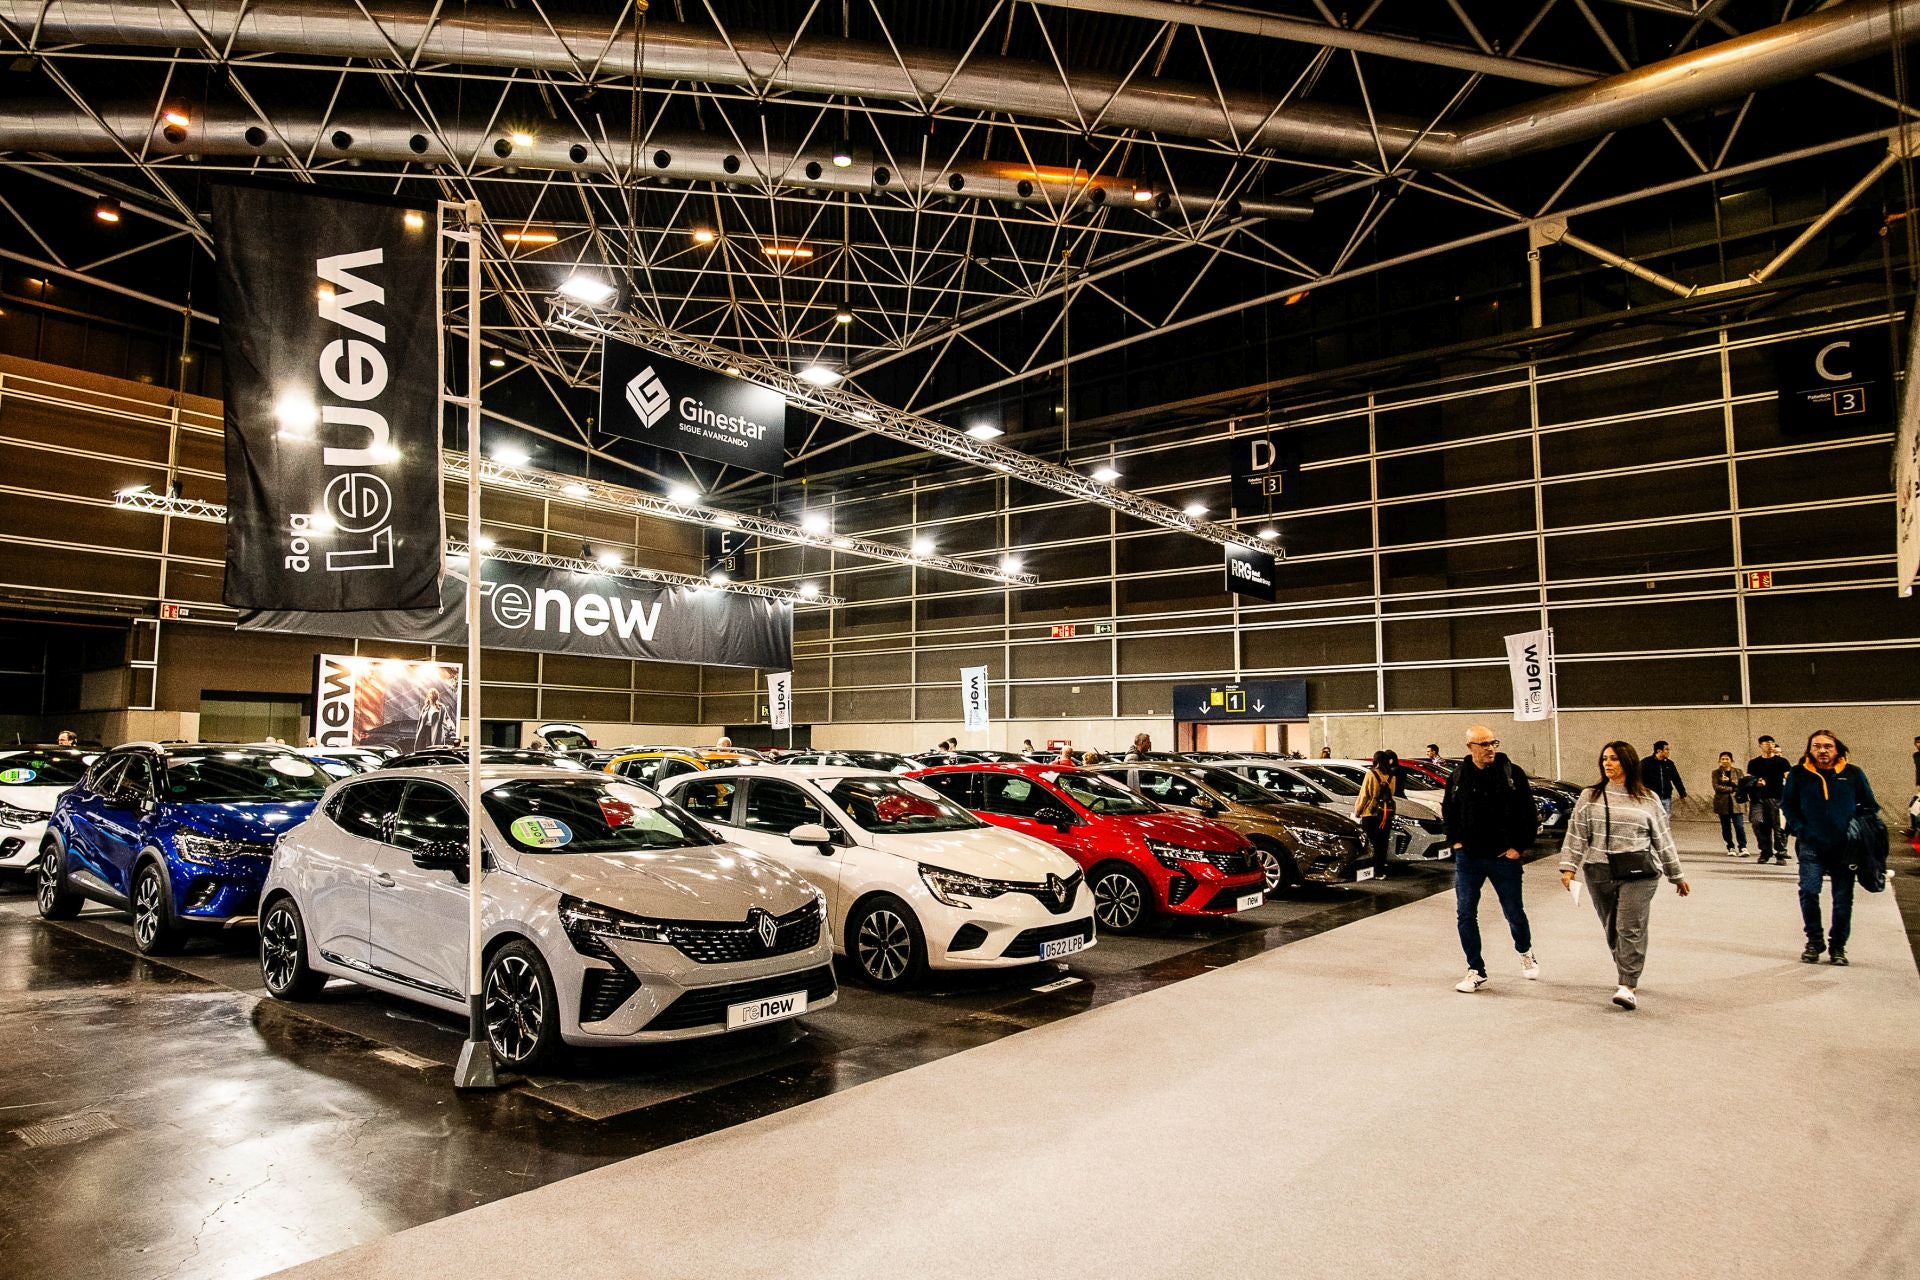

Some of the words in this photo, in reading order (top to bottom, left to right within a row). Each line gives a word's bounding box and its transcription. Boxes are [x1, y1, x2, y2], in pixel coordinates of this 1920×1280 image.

[1815, 341, 1853, 381] C
[1842, 393, 1856, 410] 3
[679, 396, 767, 441] Ginestar
[679, 422, 702, 436] SIGUE
[702, 429, 749, 448] AVANZANDO
[1251, 439, 1276, 471] D
[1268, 478, 1277, 492] 3
[721, 531, 731, 554] E
[727, 559, 733, 569] 3
[1231, 558, 1252, 580] RRG
[465, 580, 663, 642] renew
[1230, 694, 1238, 709] 1
[1045, 941, 1067, 958] 0522
[1068, 936, 1083, 952] LPB
[742, 998, 795, 1022] renew
